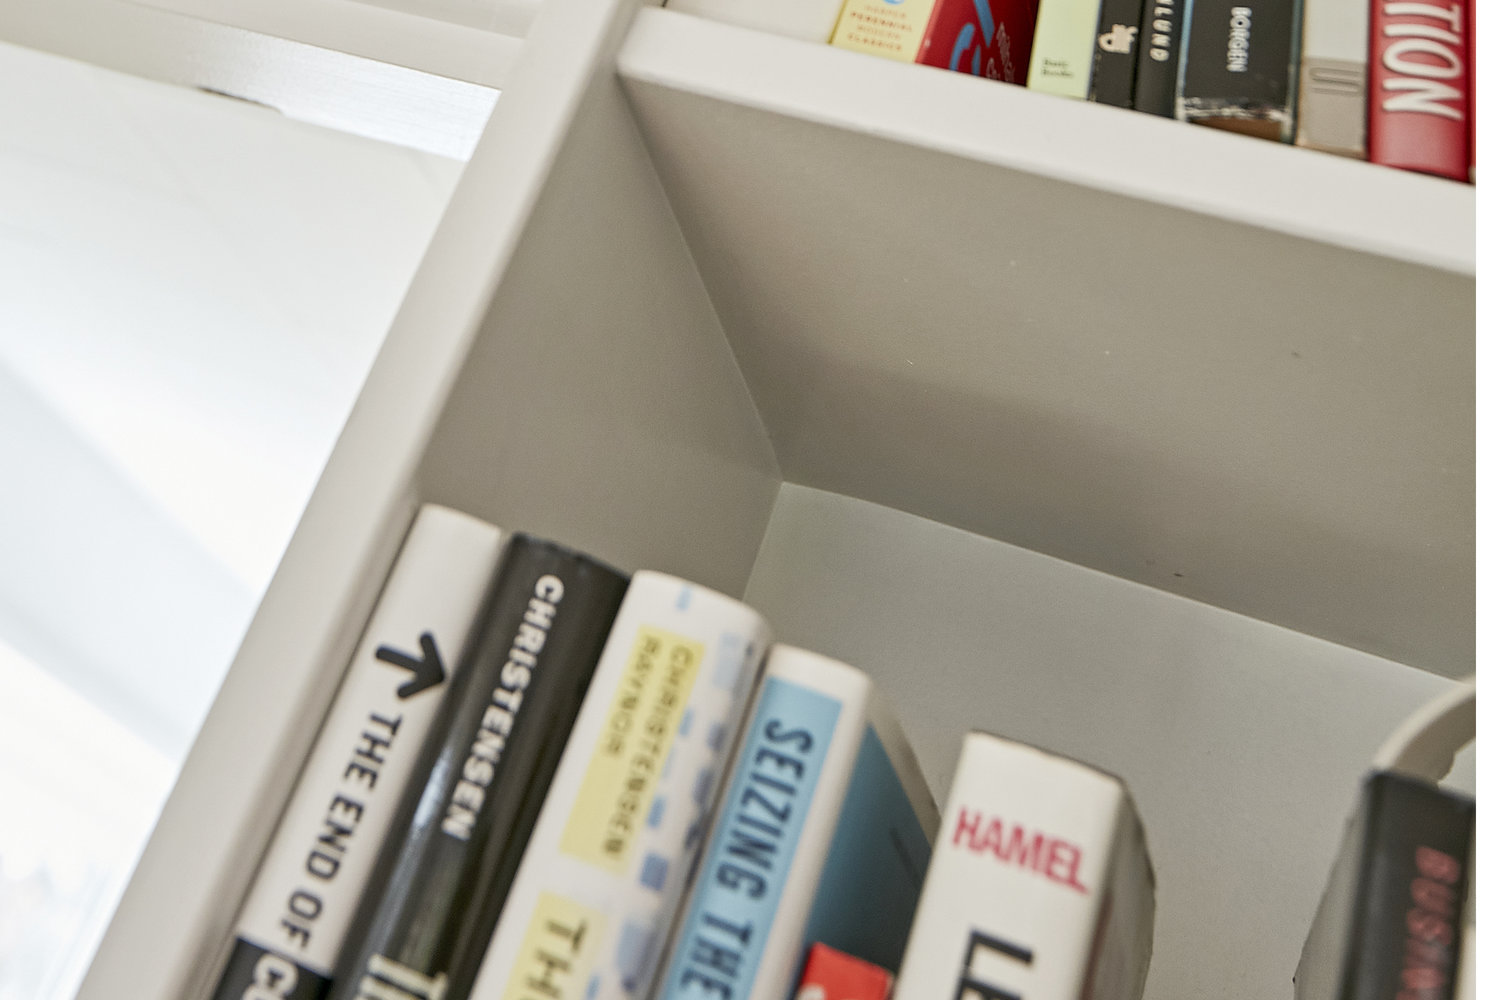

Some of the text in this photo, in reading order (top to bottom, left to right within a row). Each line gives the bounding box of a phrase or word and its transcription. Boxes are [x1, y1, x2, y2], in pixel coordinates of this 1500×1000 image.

[441, 573, 564, 842] CHRISTENSEN
[602, 635, 661, 757] RAYNOR
[602, 646, 695, 856] CHRISTENSEN
[281, 712, 402, 949] THE END OF
[680, 718, 815, 1000] SEIZING THE
[952, 804, 1091, 896] HAMEL
